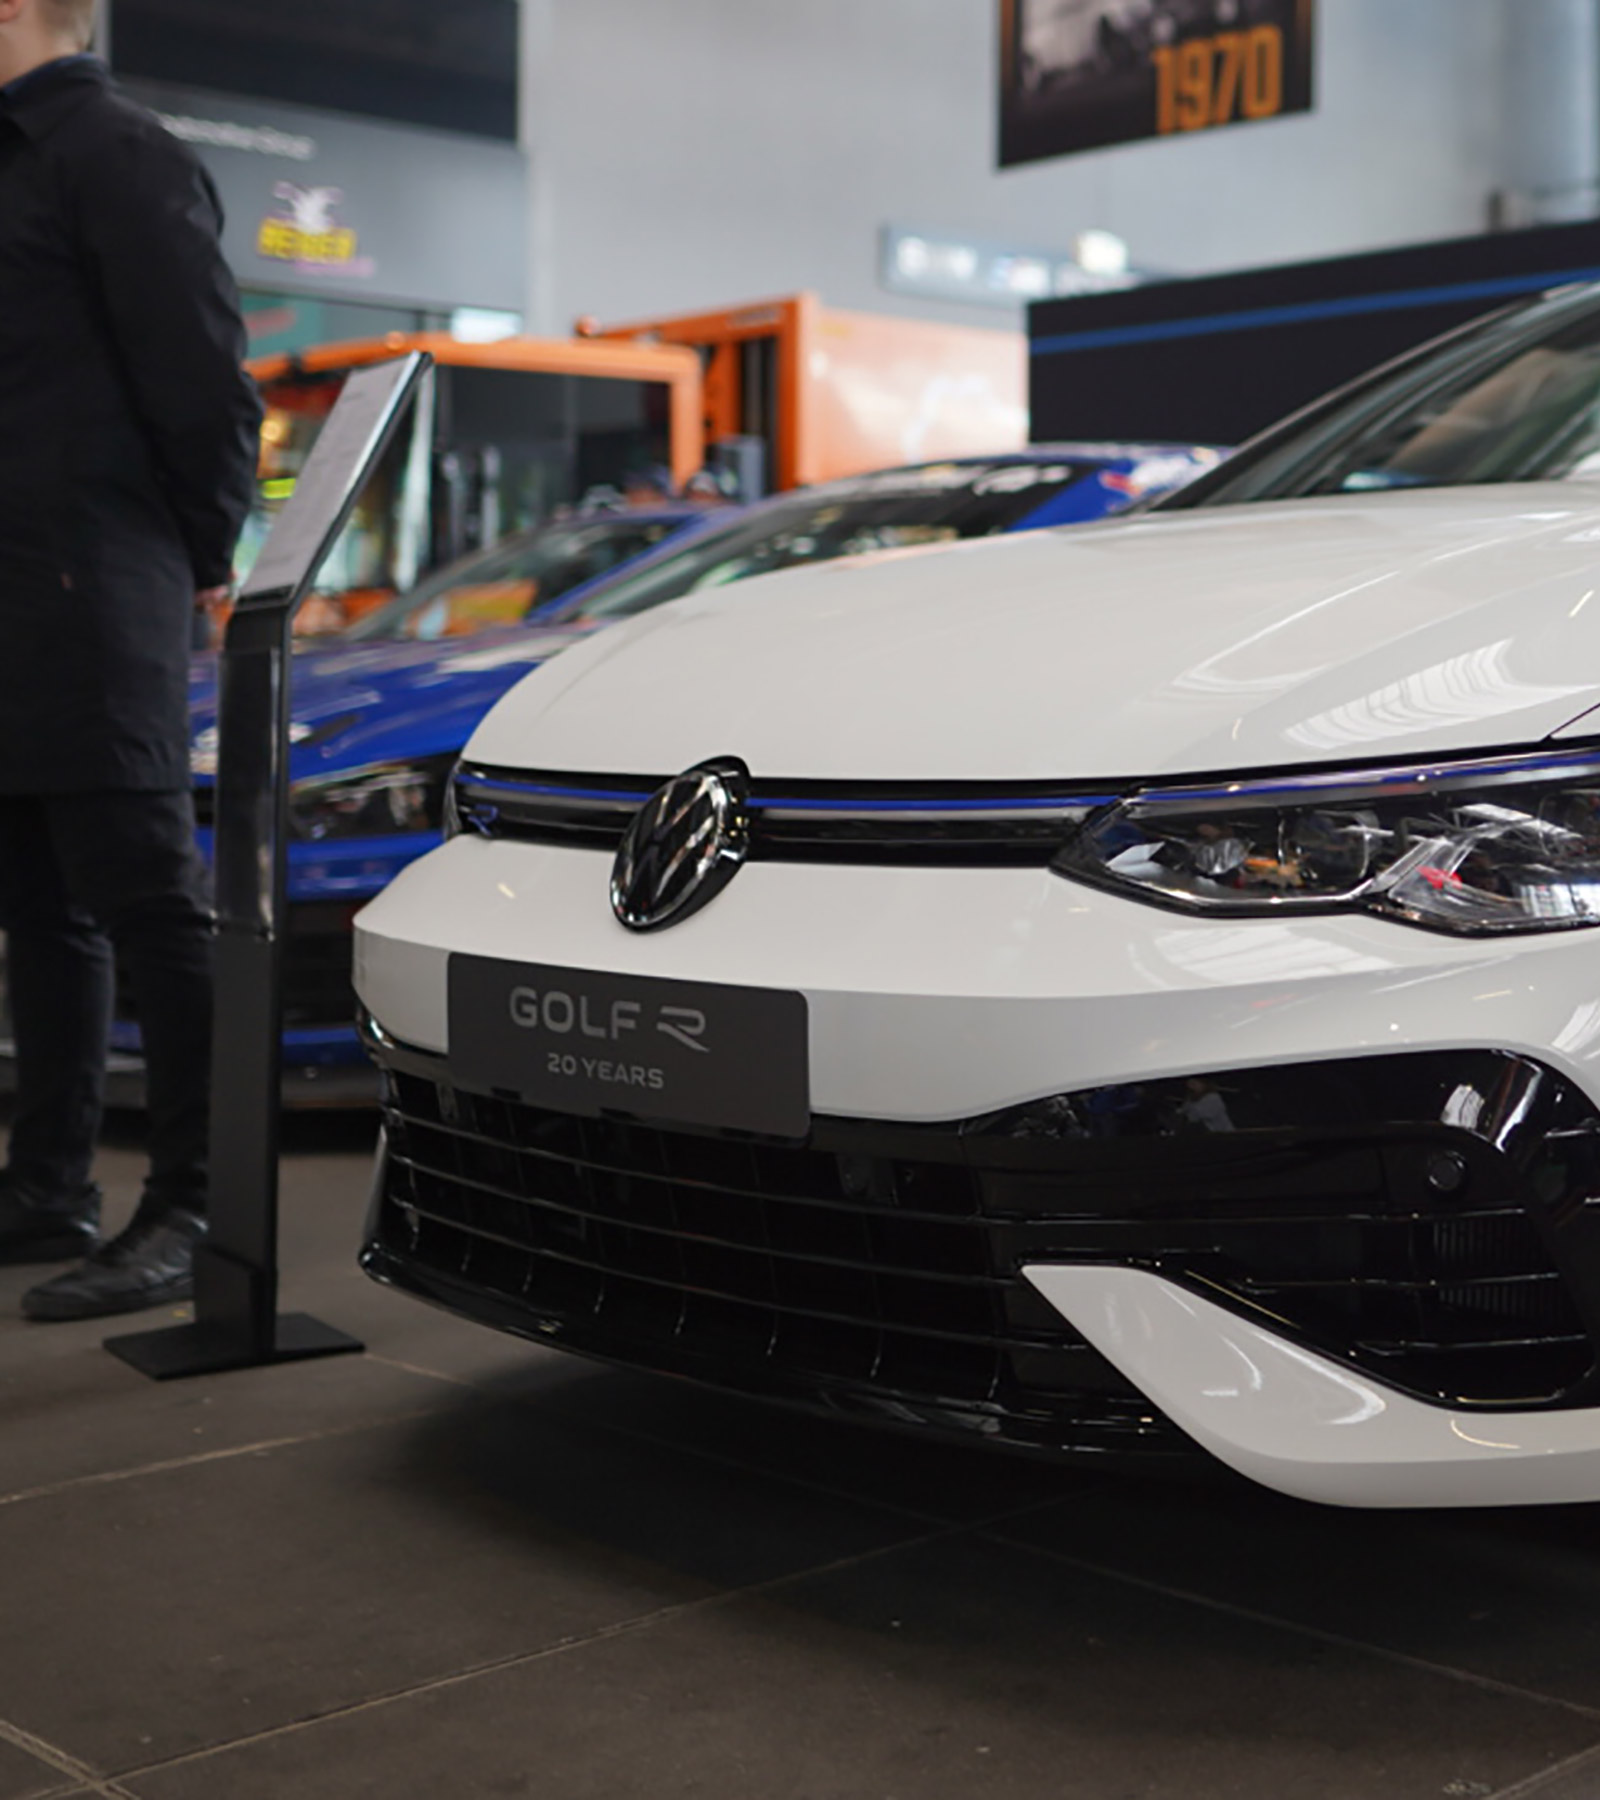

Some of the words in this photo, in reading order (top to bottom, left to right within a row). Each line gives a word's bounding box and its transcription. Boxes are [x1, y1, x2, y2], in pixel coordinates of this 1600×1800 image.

[1152, 23, 1283, 135] 1970
[509, 986, 642, 1040] GOLF
[656, 1005, 710, 1053] R
[547, 1053, 577, 1076] 20
[581, 1056, 664, 1089] YEARS
